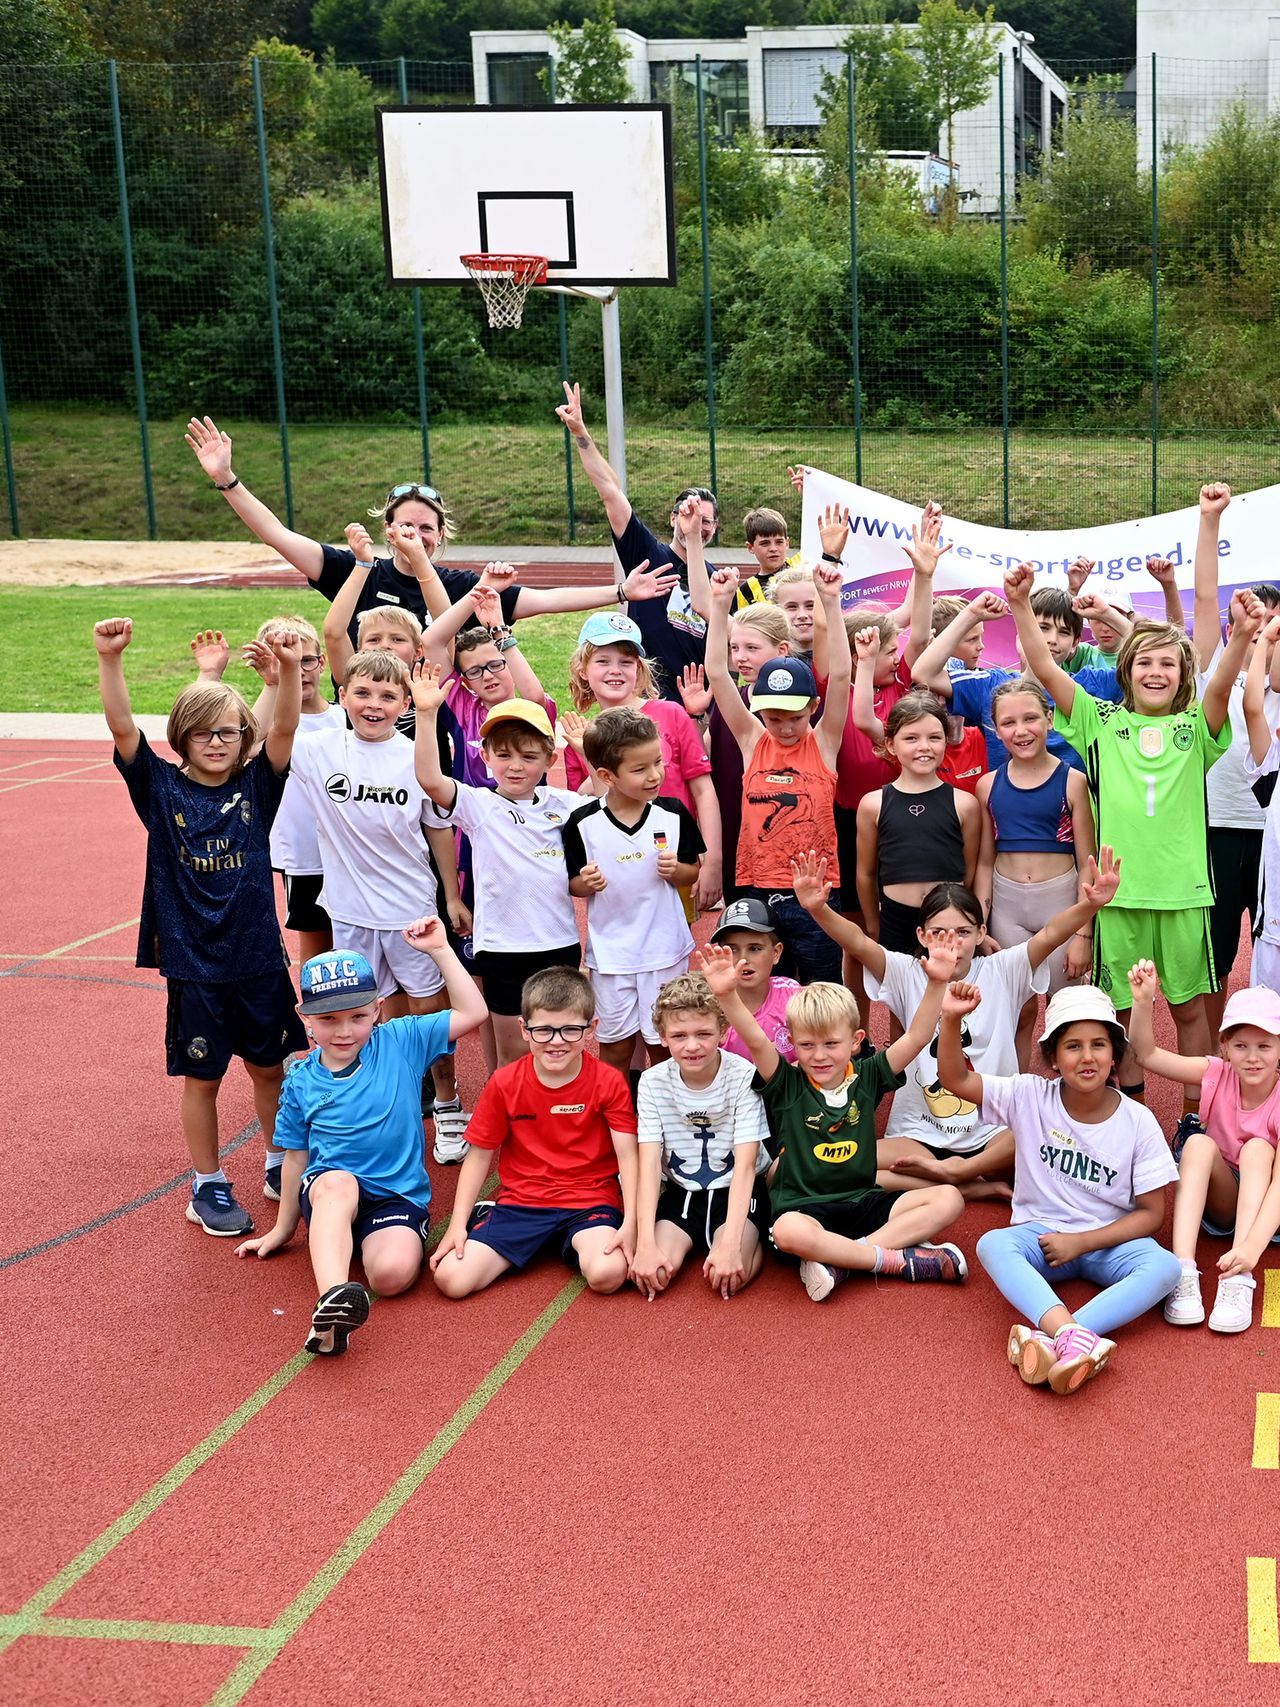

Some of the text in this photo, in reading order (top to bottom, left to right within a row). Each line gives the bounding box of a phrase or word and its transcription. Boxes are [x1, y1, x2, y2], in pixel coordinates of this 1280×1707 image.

[353, 784, 409, 806] JAKO
[1144, 775, 1155, 817] 1
[311, 977, 359, 994] FREESTYLE
[822, 1144, 851, 1158] MTN
[1040, 1144, 1118, 1187] SYDNEY
